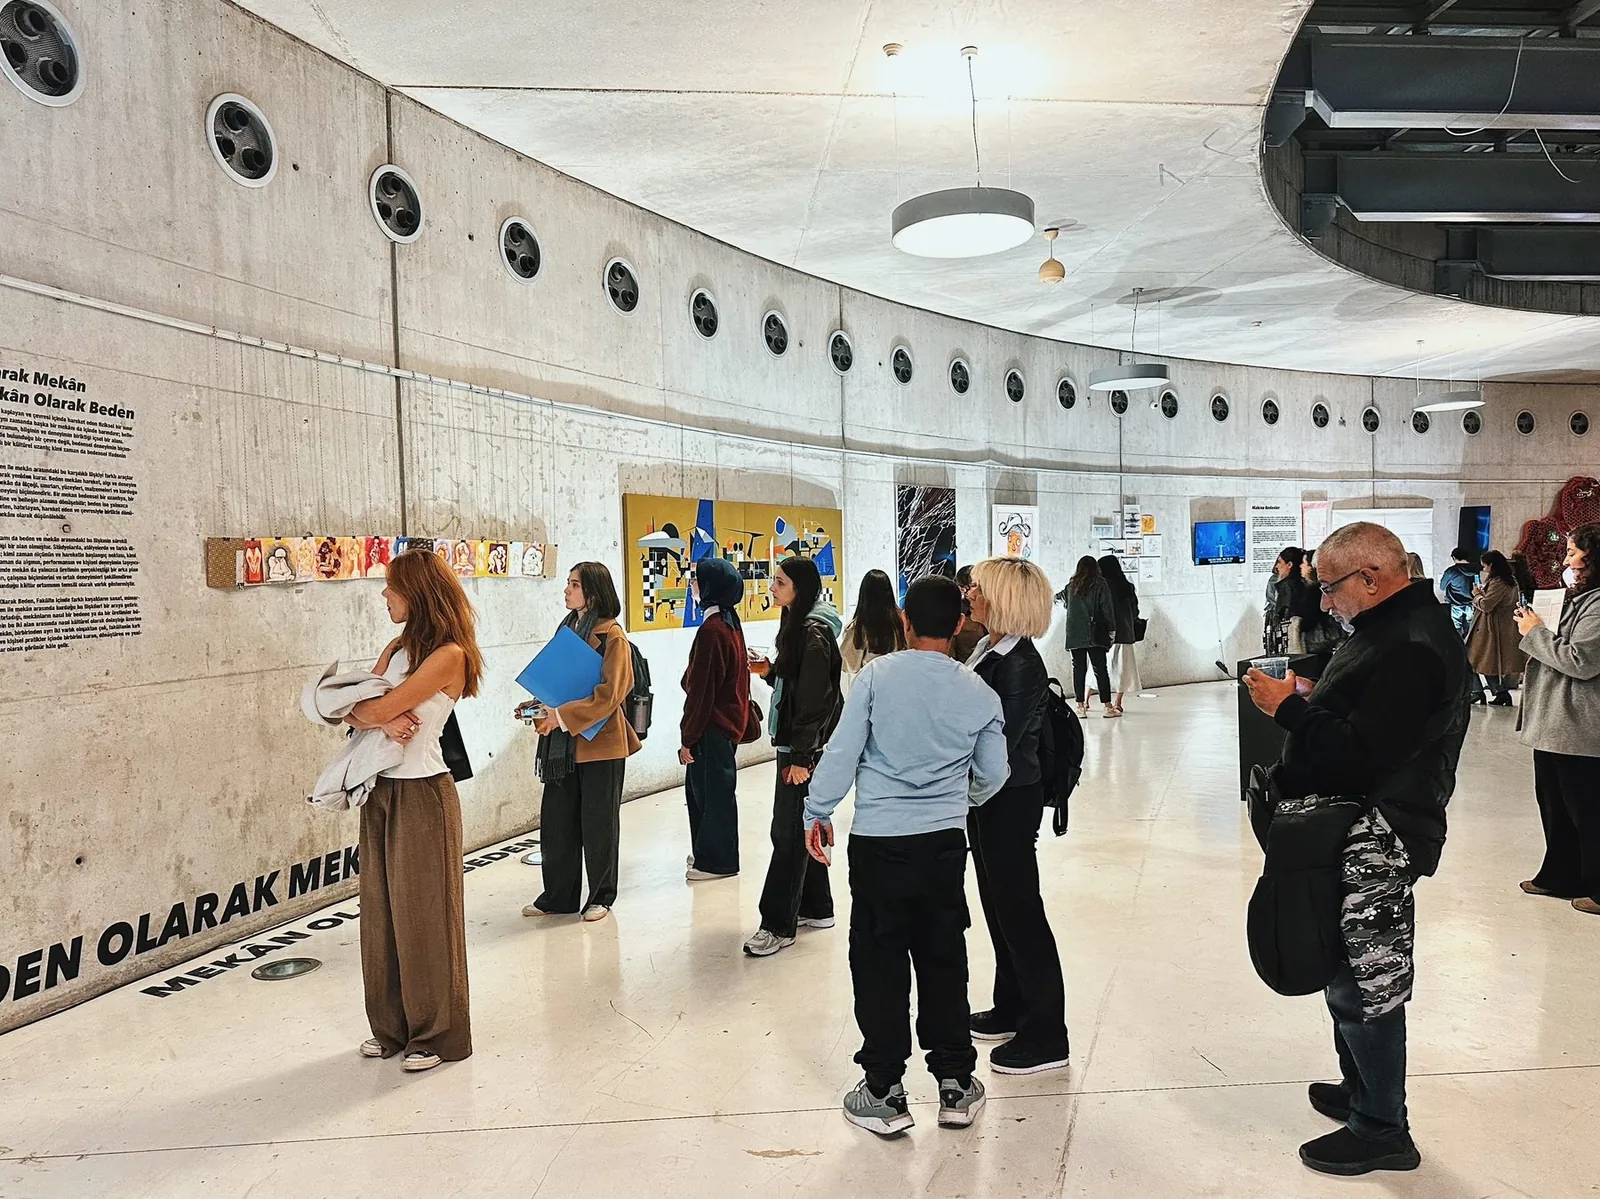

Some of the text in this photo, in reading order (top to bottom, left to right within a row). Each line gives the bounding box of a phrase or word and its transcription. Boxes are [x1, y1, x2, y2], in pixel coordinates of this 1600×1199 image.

[0, 368, 86, 392] rak Mekân
[33, 392, 86, 412] Olarak
[89, 401, 135, 419] Beden
[97, 870, 281, 966] OLARAK
[140, 930, 312, 998] MEKÂN
[306, 903, 360, 930] OL
